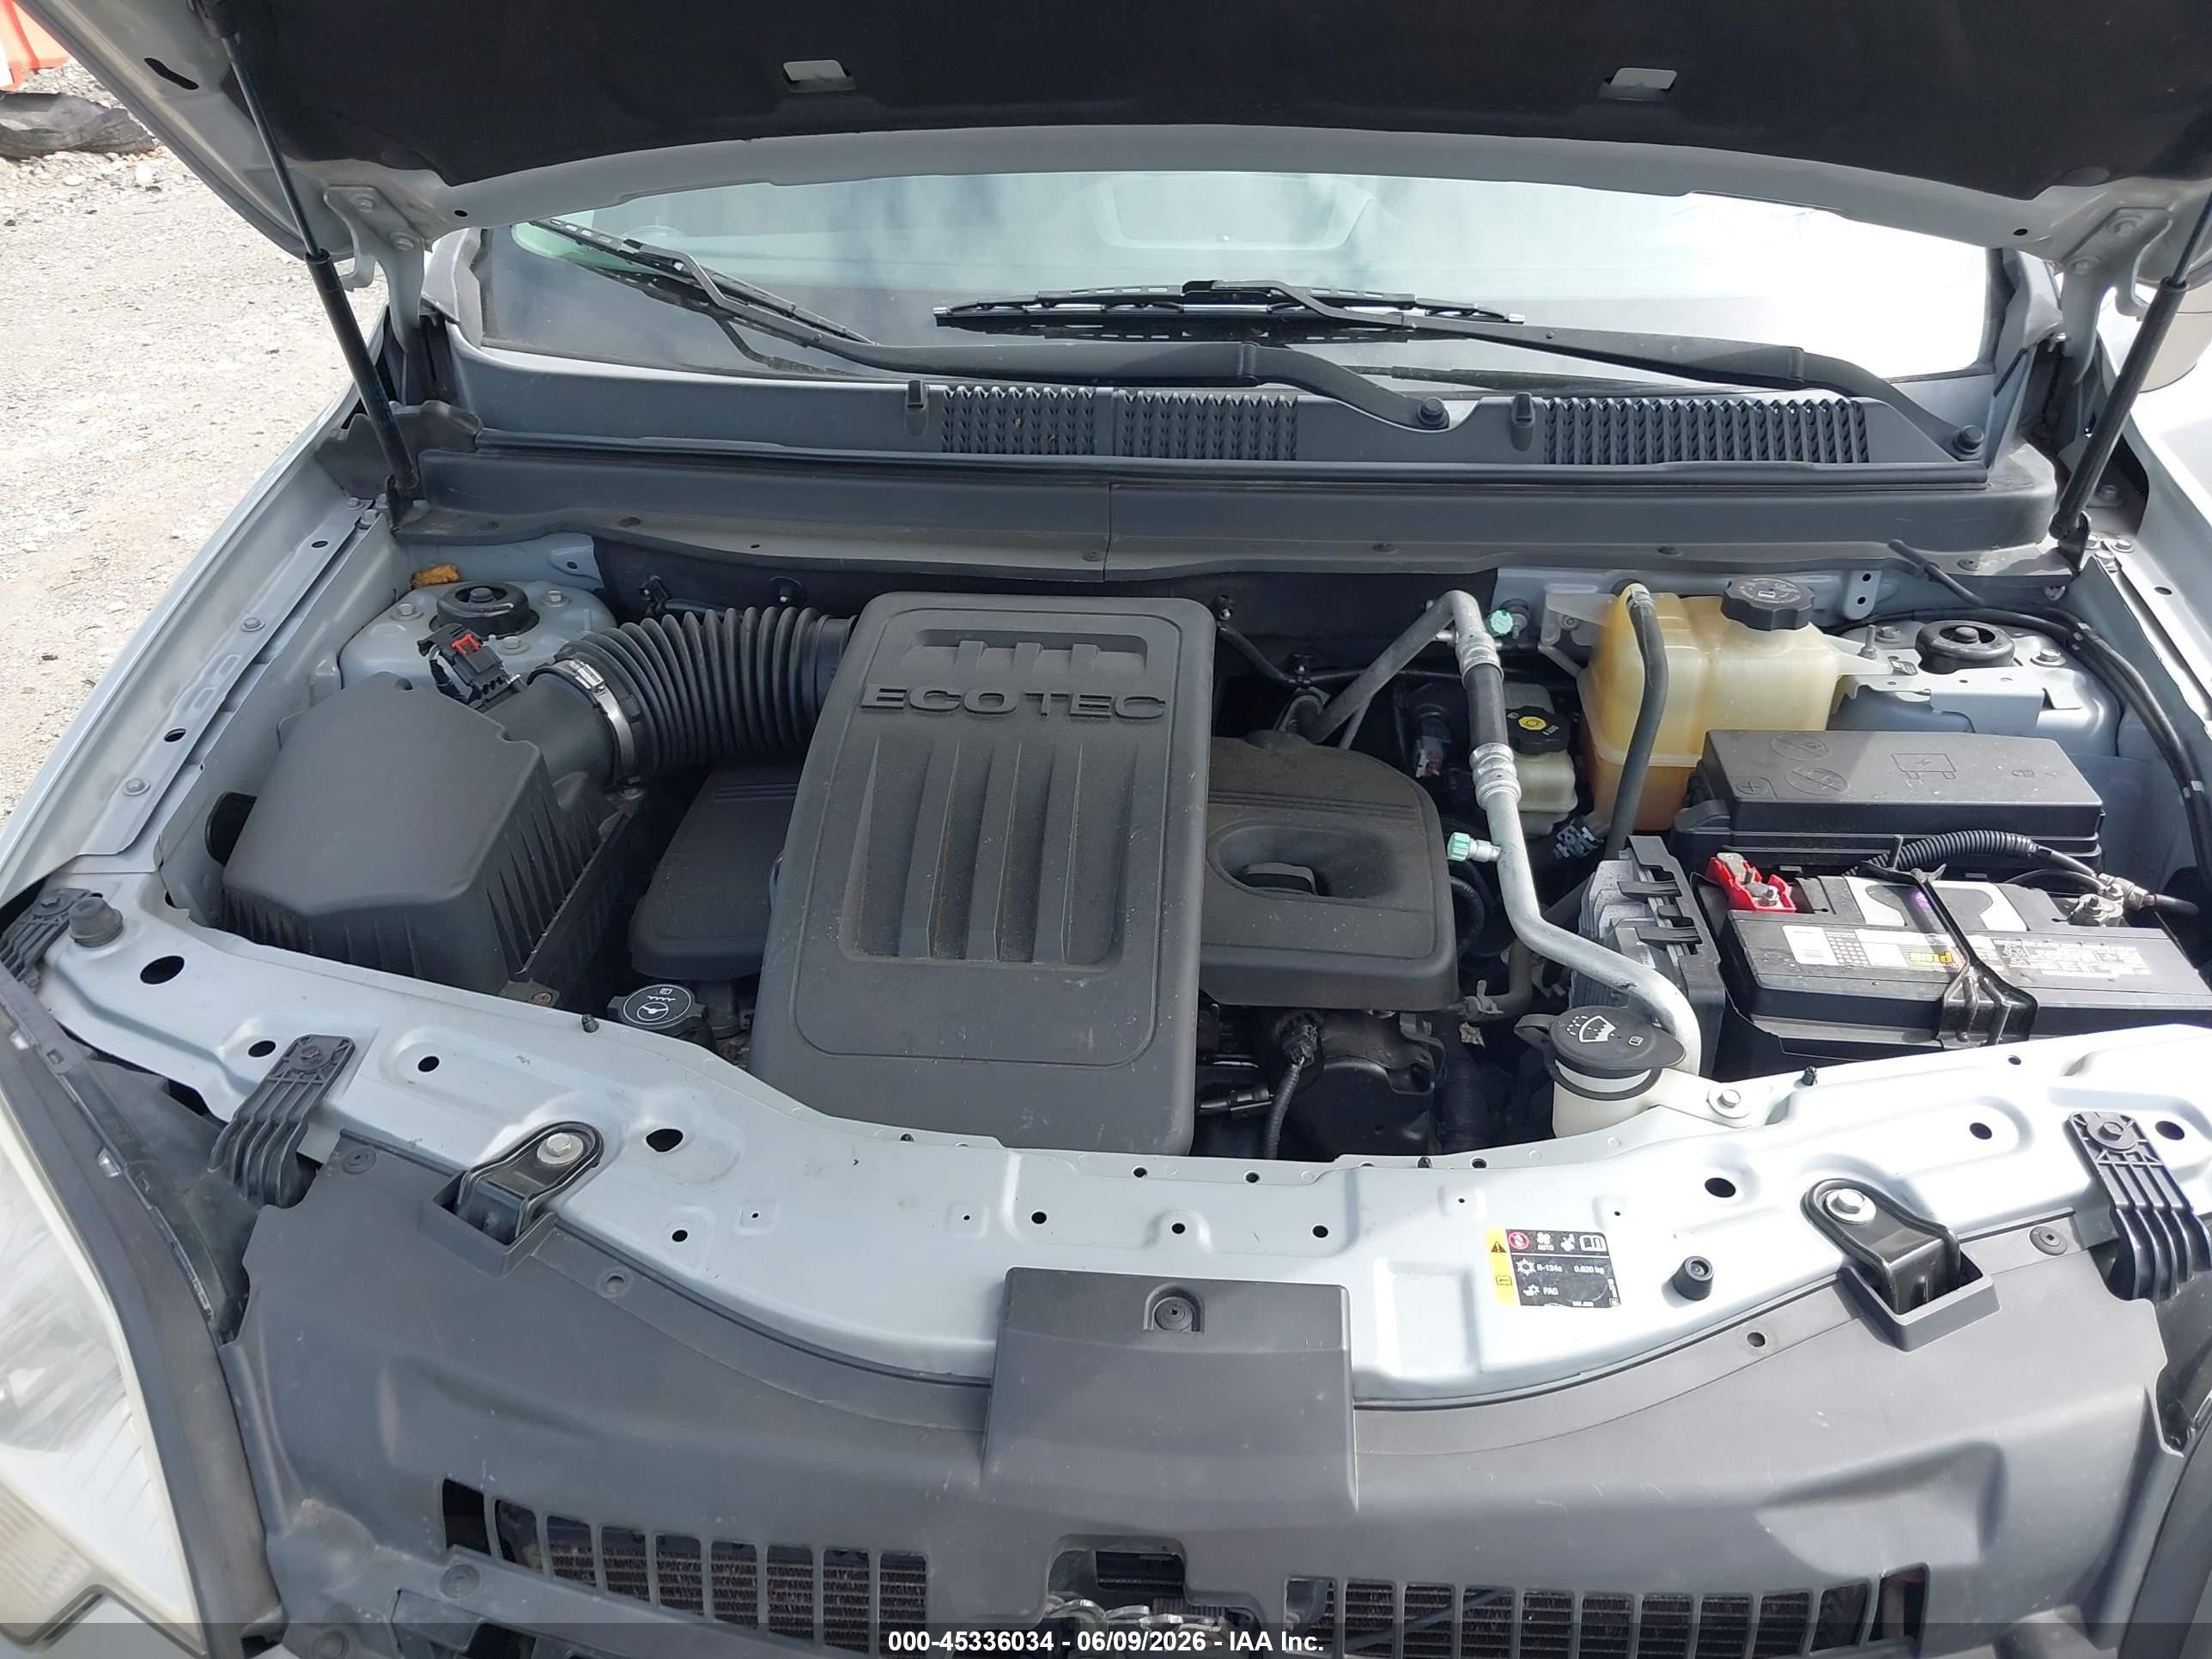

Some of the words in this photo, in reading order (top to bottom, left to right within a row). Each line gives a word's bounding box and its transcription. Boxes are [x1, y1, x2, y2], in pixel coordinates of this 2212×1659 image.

[860, 686, 1167, 720] ECOTEC
[1537, 1264, 1563, 1273] R-134a
[1595, 1266, 1605, 1274] kg
